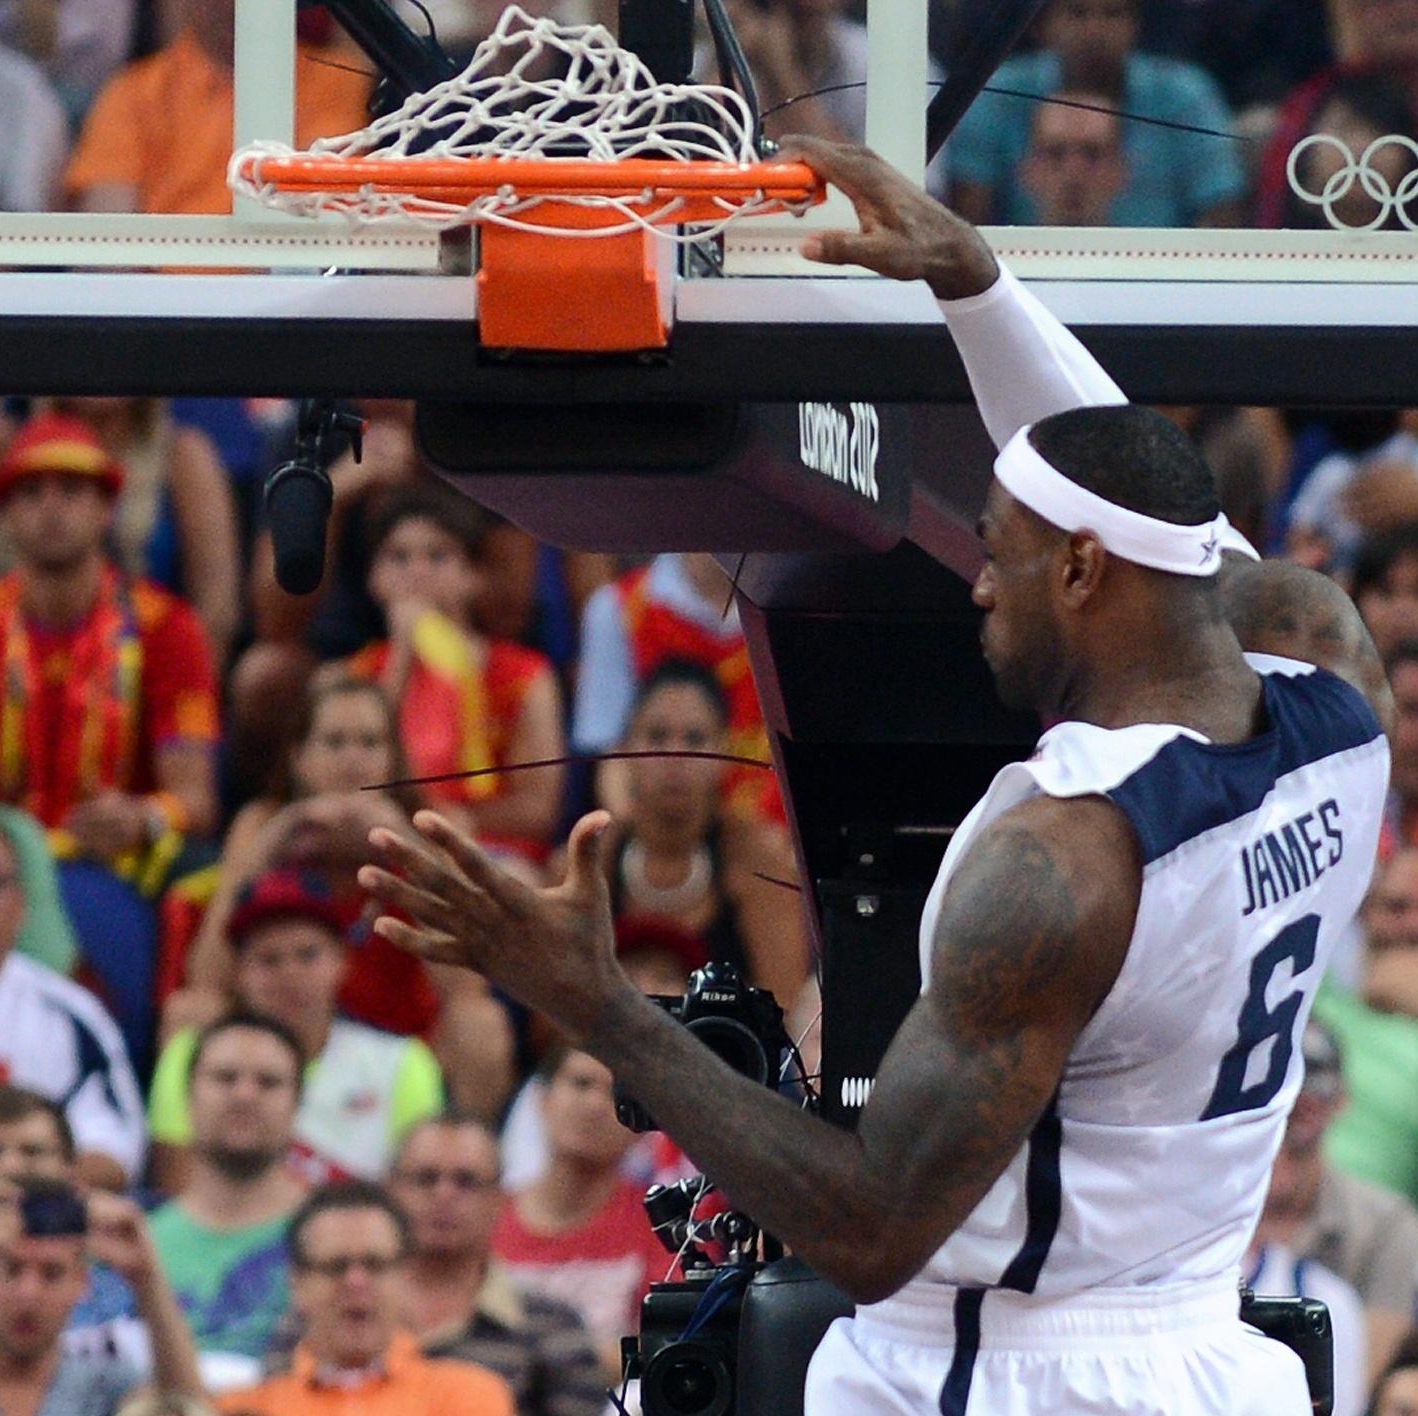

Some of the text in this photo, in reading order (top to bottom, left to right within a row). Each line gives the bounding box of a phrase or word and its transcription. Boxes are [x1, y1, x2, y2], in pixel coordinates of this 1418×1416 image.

[1242, 798, 1343, 916] JAMES
[701, 991, 736, 1002] Nikon
[1199, 912, 1322, 1122] 6
